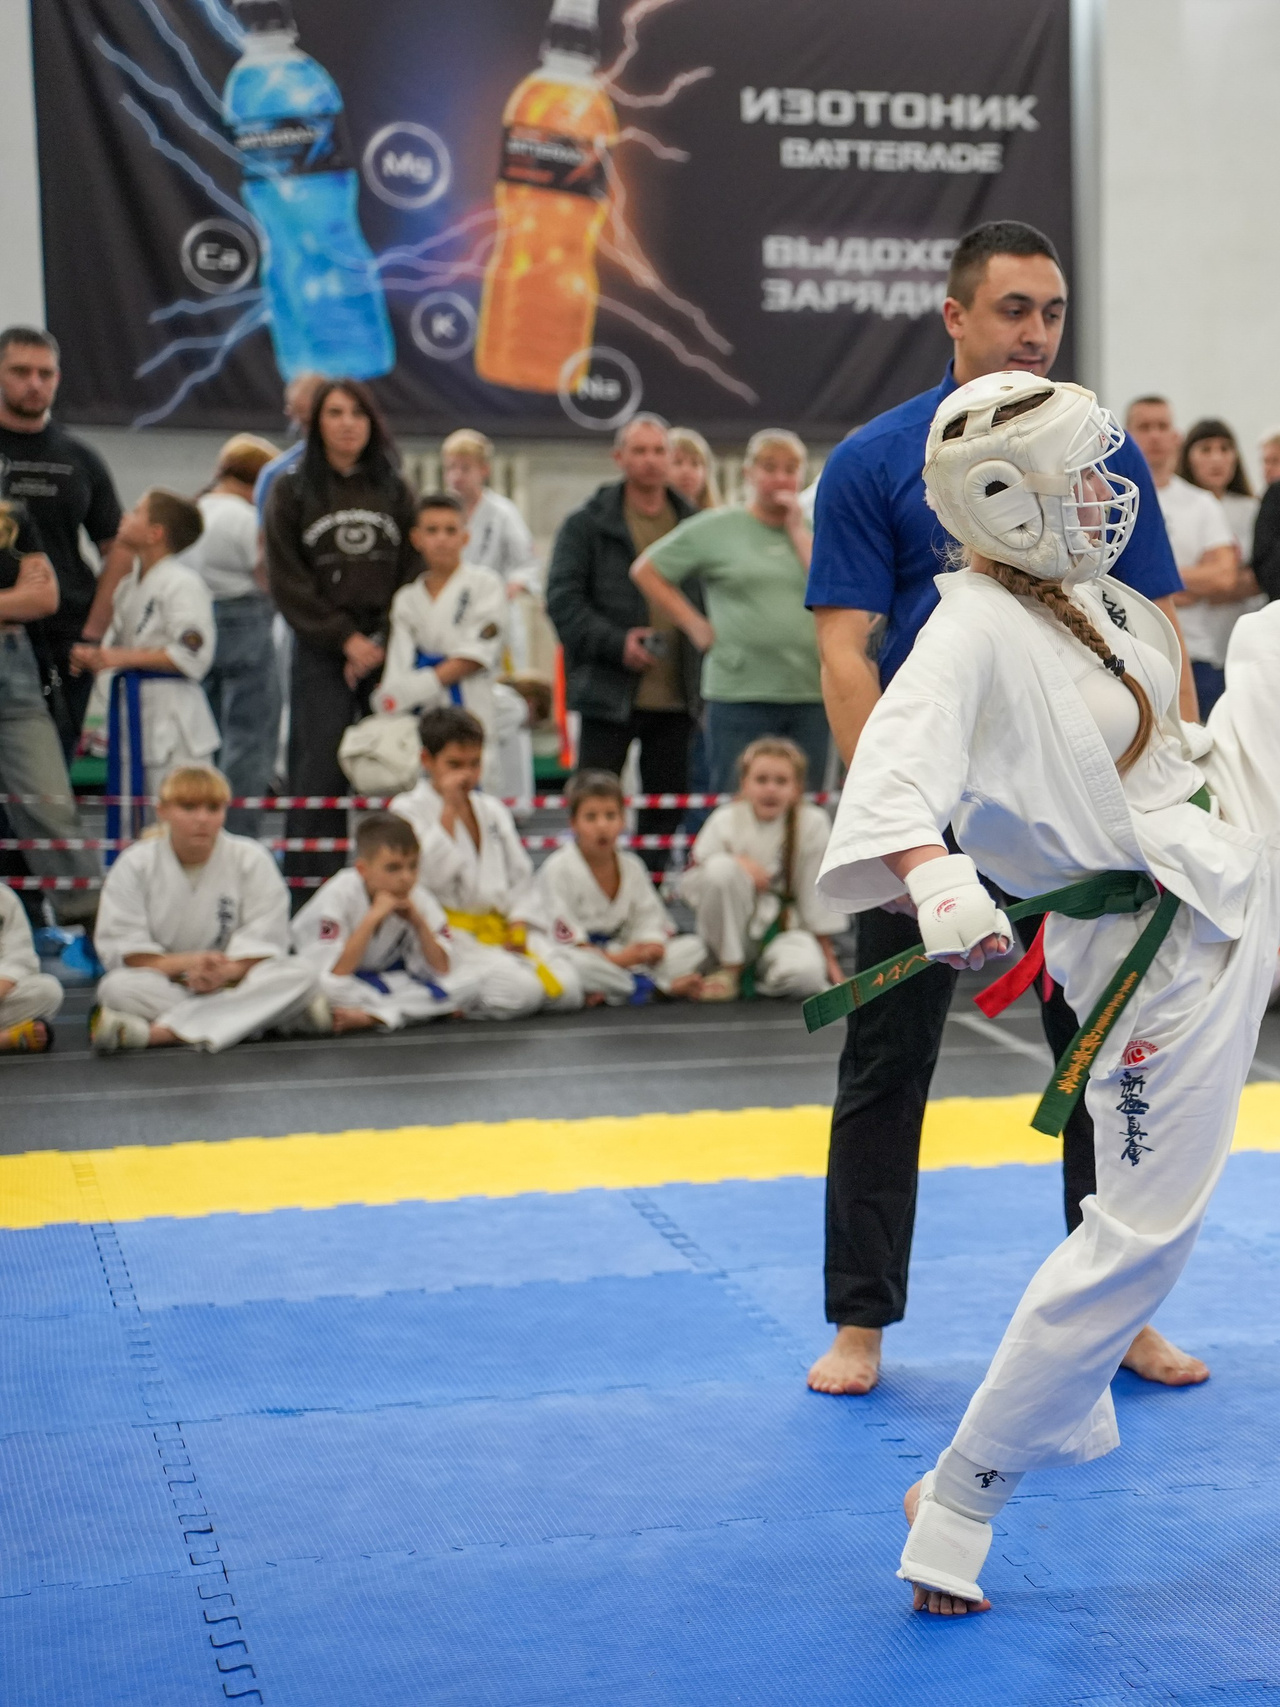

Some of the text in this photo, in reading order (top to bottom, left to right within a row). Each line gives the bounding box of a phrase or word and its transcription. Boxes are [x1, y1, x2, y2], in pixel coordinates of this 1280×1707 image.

[740, 86, 1040, 132] ИЗОТОНИК
[381, 149, 434, 185] Mg
[779, 136, 1004, 174] BATTERADE
[431, 311, 458, 340] K
[576, 373, 622, 402] Na
